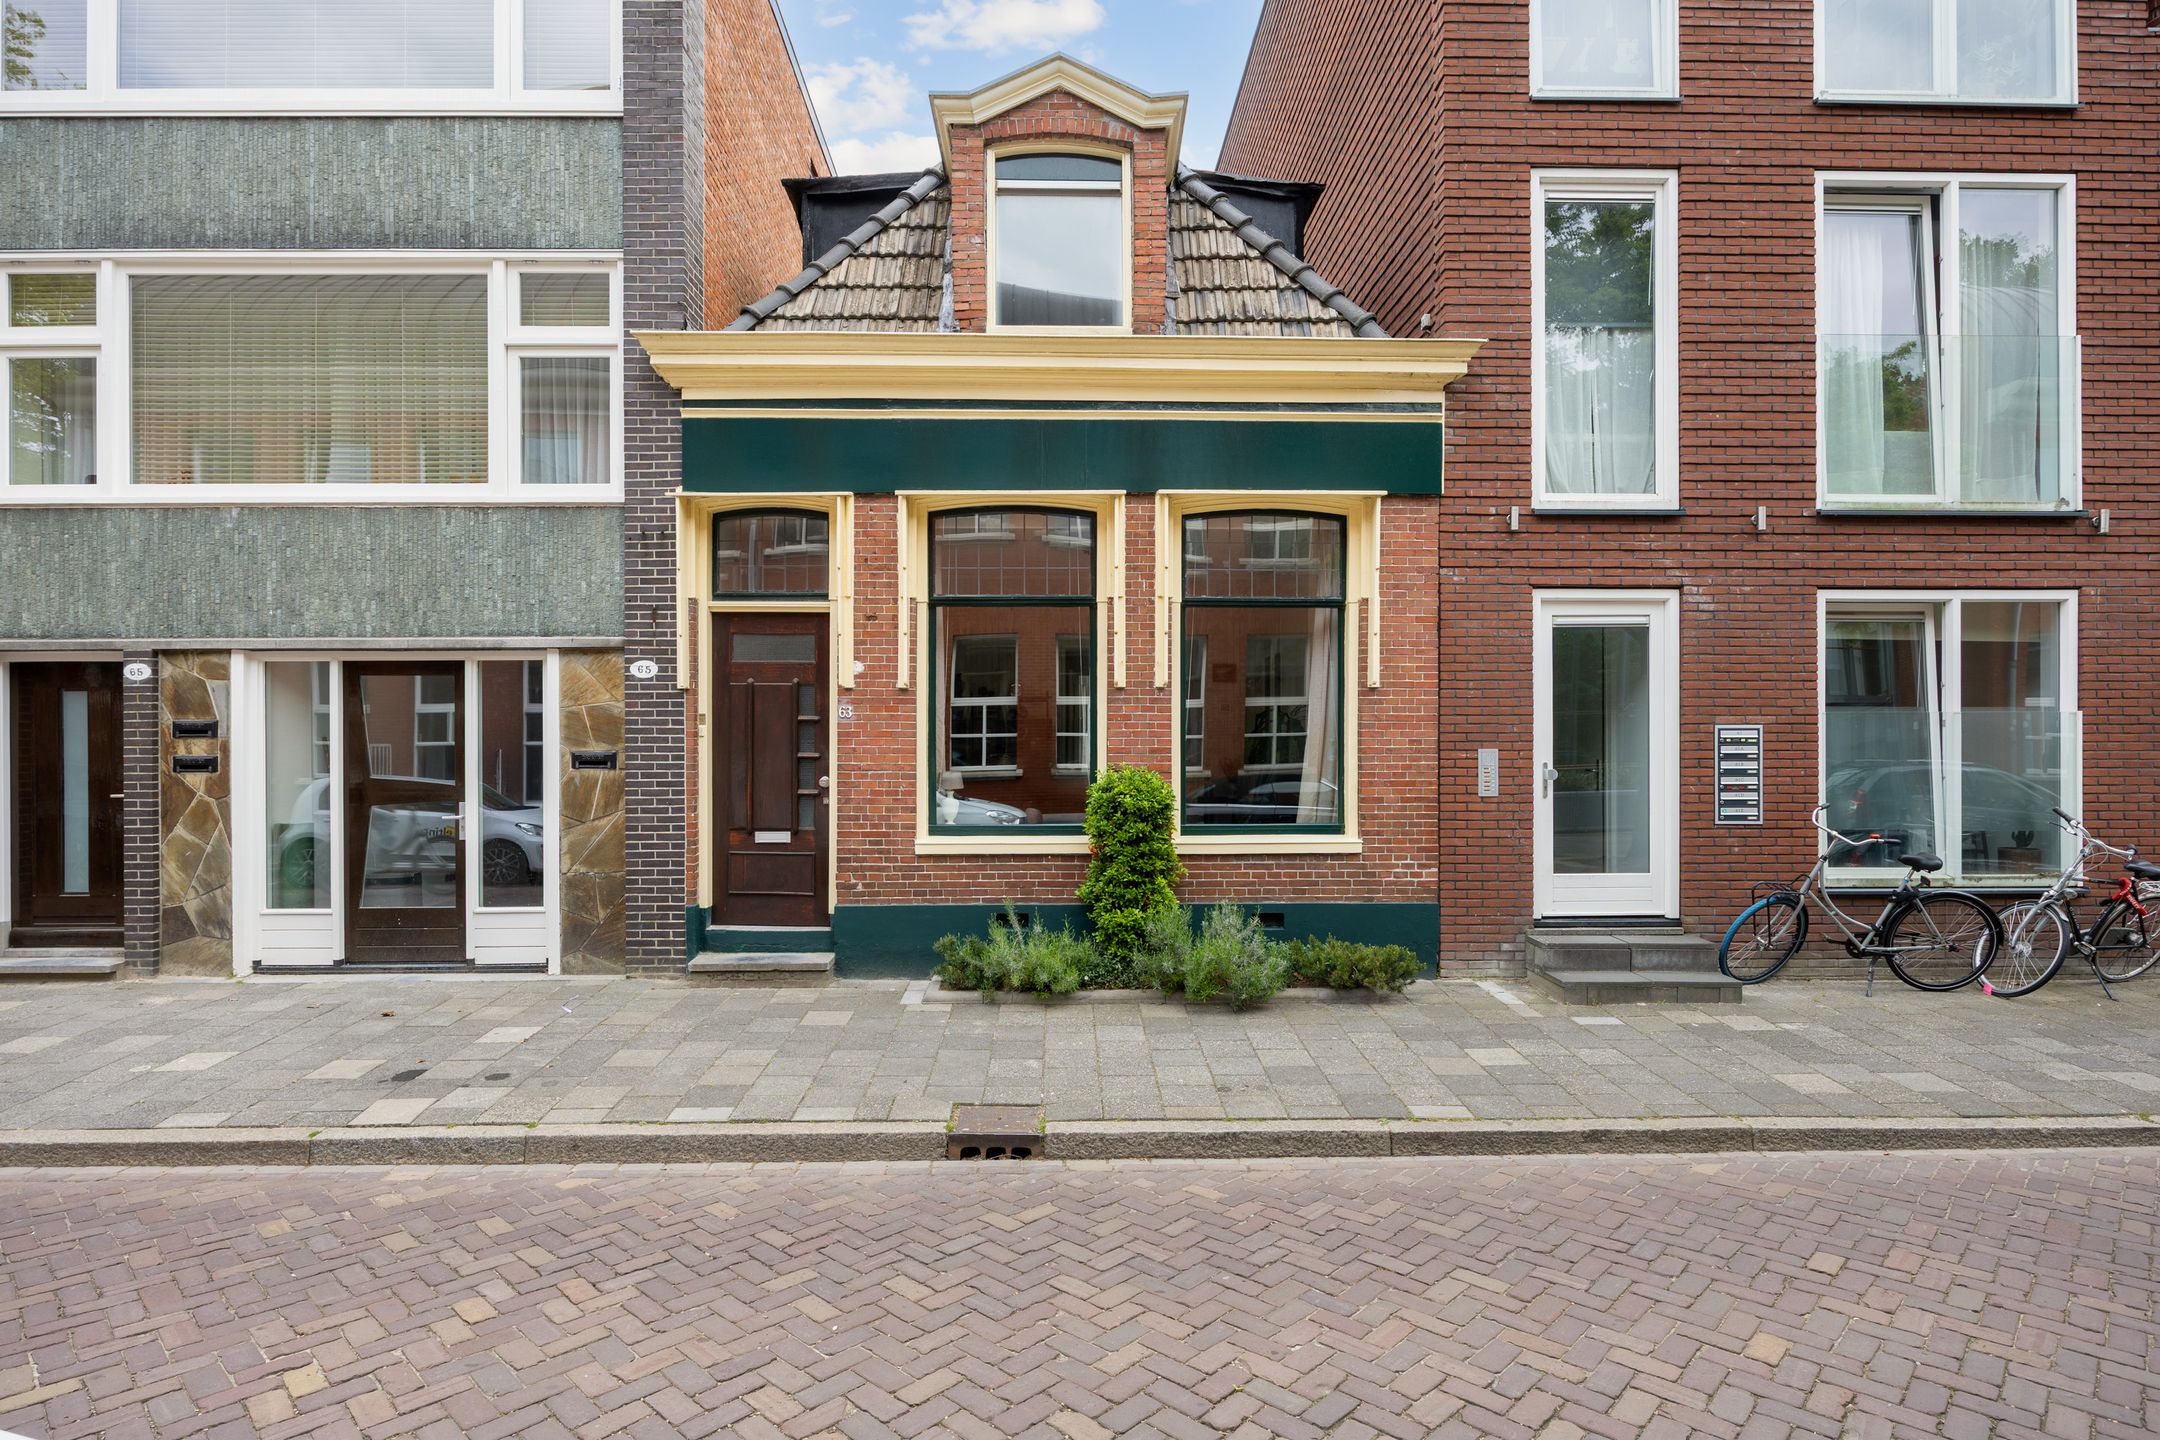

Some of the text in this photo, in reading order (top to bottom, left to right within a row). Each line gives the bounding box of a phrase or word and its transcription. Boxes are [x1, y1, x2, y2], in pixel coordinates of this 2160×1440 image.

[130, 668, 143, 676] 65
[638, 665, 651, 674] 65
[839, 706, 852, 718] 63
